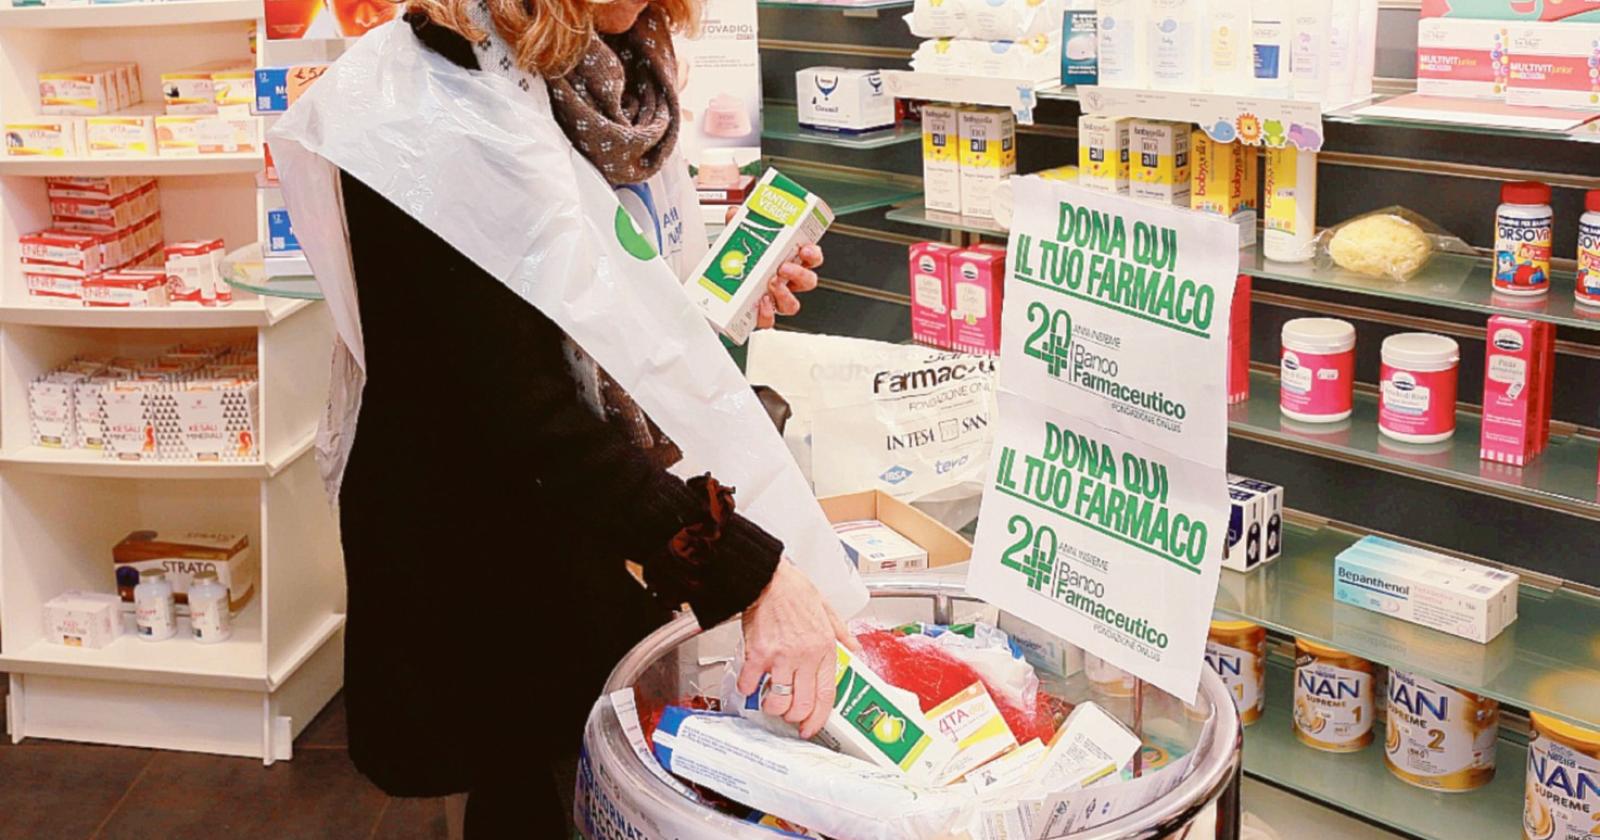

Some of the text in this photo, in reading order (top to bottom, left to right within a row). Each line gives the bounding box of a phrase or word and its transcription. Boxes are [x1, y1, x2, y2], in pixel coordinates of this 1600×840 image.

[1420, 54, 1461, 65] MULTIVIT
[1510, 61, 1553, 73] MULTIVIT
[972, 139, 986, 151] all
[758, 198, 791, 222] VERDE
[760, 189, 800, 214] TANTUM
[1057, 201, 1178, 273] DONA QUI
[1015, 233, 1215, 331] IL TUO FARMACO
[1074, 343, 1119, 377] Banco
[1074, 364, 1186, 420] Farmaceutico
[1111, 402, 1182, 433] FONDAZIONE ONLUS
[186, 432, 223, 440] MINERALI
[886, 428, 935, 451] INTESA
[935, 455, 969, 475] teva
[1043, 421, 1169, 504] DONA QUI
[996, 446, 1208, 566] IL TUO FARMACO
[162, 560, 216, 573] STRATO
[1059, 560, 1105, 599] Banco
[1337, 566, 1410, 595] Bepanthenol
[1055, 581, 1169, 650] Farmaceutico
[1093, 623, 1137, 652] FONDAZIONE
[1204, 654, 1241, 676] AN
[1233, 683, 1244, 701] 1
[1298, 669, 1360, 700] NAN
[1306, 694, 1348, 709] SUPREME
[1352, 705, 1362, 725] 1
[1428, 728, 1446, 753] 2
[1534, 783, 1591, 813] SUPREME
